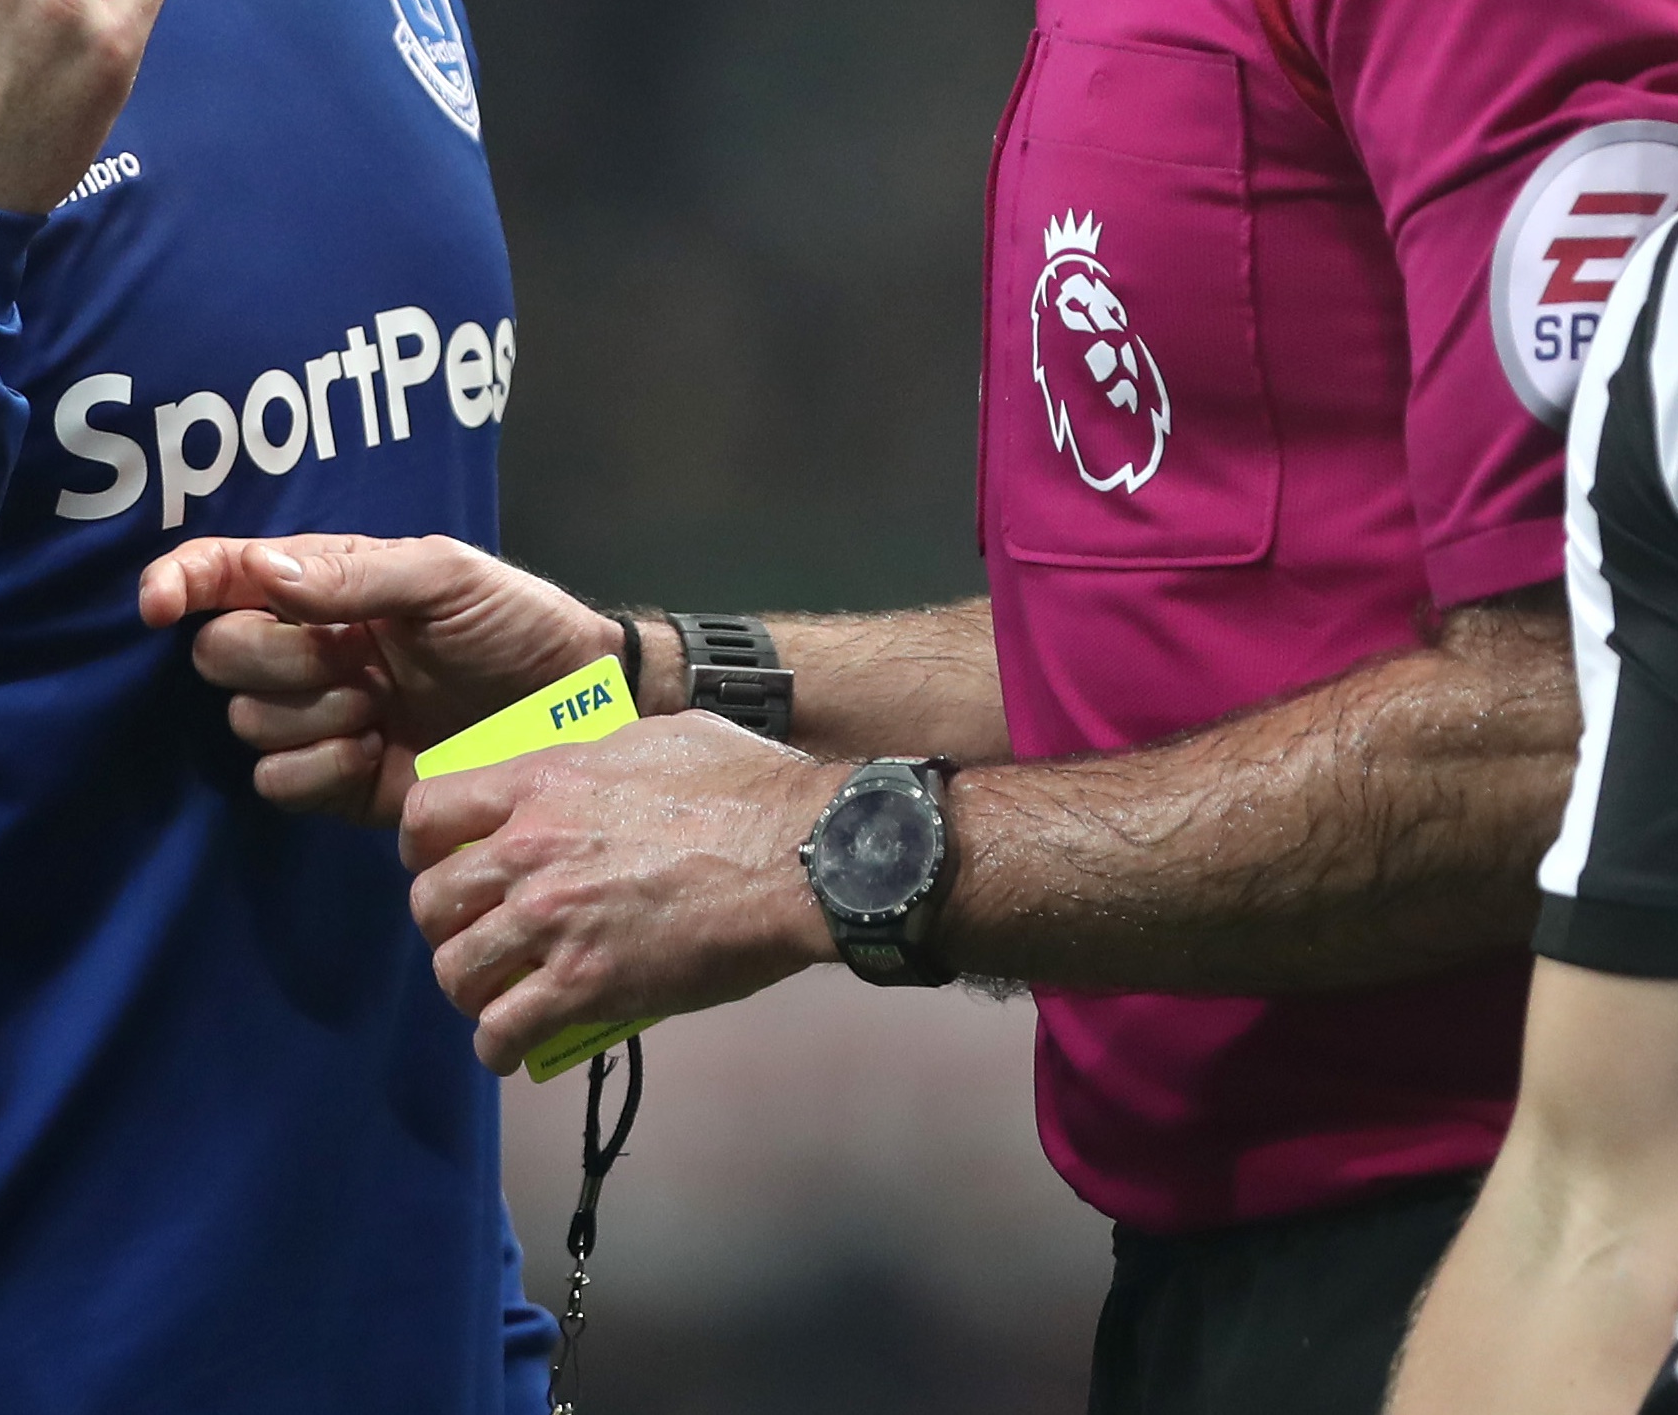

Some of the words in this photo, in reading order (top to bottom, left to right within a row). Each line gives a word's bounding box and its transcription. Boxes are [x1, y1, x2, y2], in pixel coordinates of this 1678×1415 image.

[55, 151, 141, 209] mbro
[1534, 312, 1605, 363] SP
[54, 305, 518, 530] SportPes
[549, 682, 613, 731] FIFA
